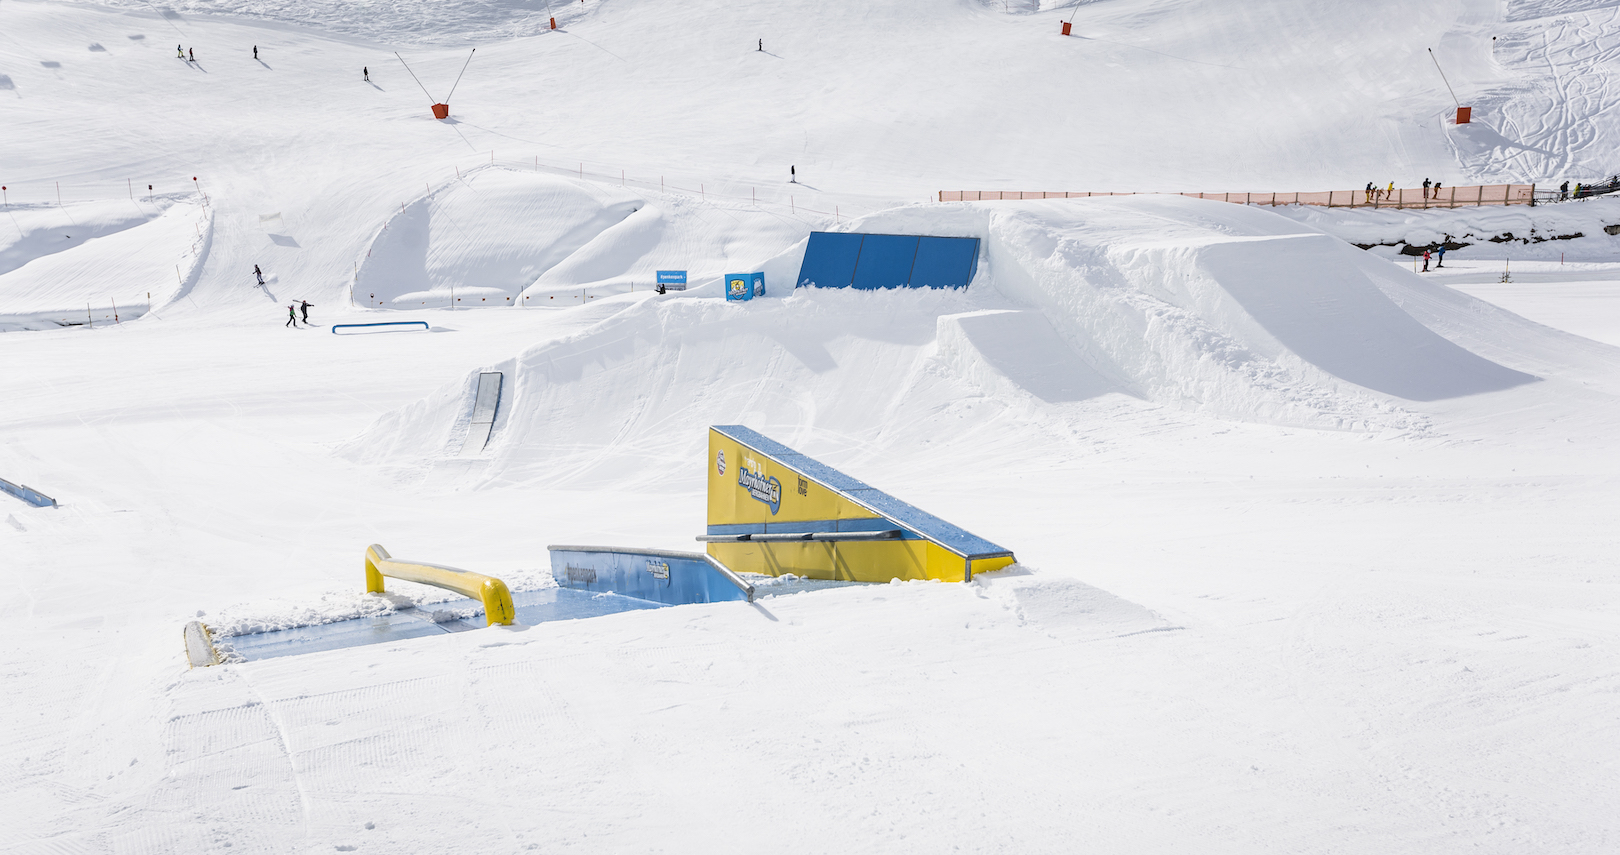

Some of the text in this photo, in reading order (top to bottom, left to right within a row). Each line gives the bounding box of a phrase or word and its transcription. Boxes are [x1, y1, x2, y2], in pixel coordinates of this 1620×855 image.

[739, 468, 772, 495] Mayrhofner
[798, 475, 808, 489] form
[798, 485, 807, 497] love
